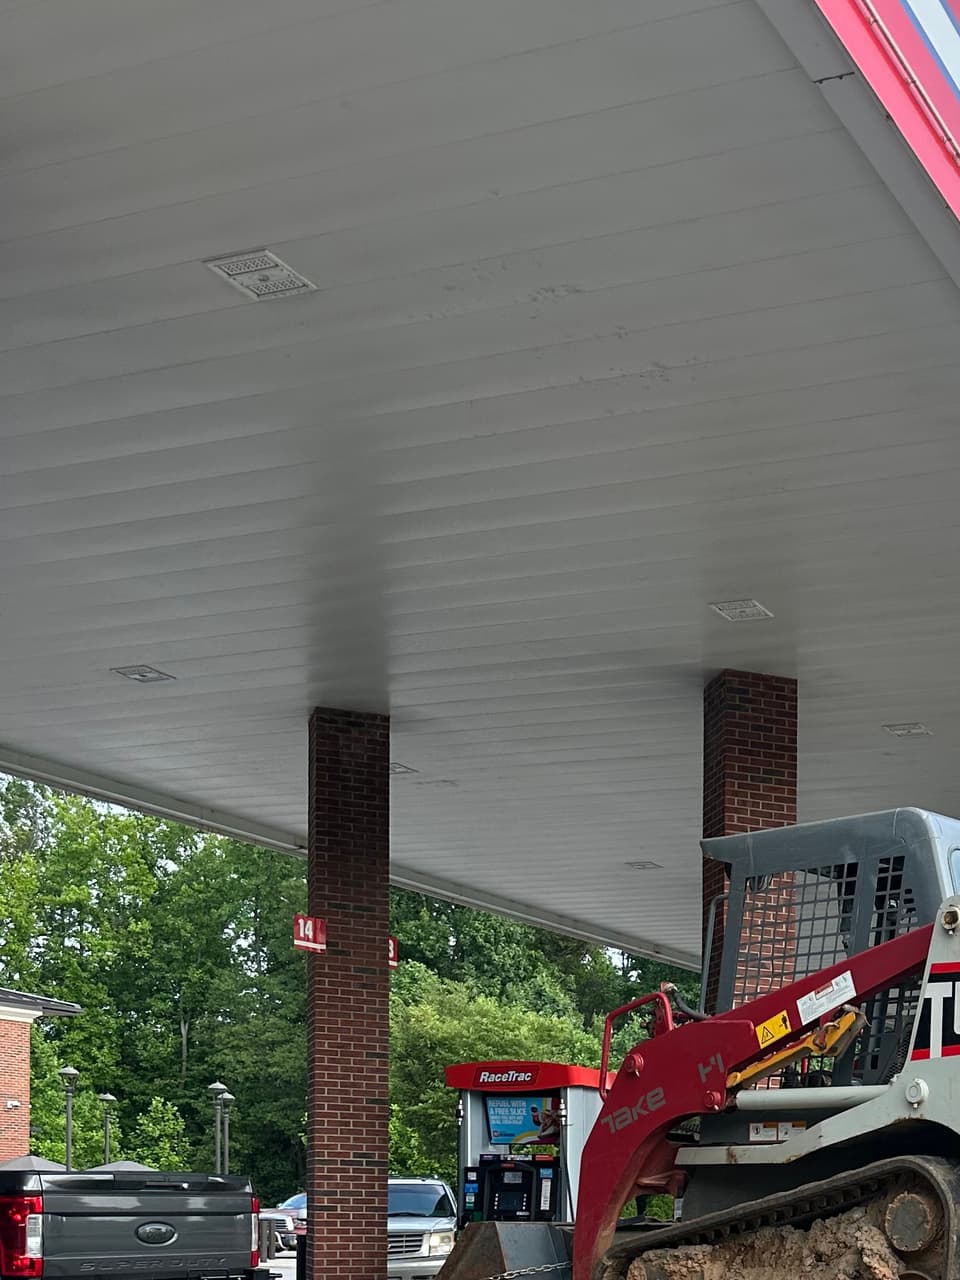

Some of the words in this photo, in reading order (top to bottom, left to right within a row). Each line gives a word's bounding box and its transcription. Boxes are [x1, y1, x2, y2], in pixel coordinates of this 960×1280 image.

[298, 919, 313, 938] 14
[479, 1070, 532, 1082] RaceTrac
[80, 1260, 163, 1271] SUPER
[170, 1257, 226, 1267] DUTY
